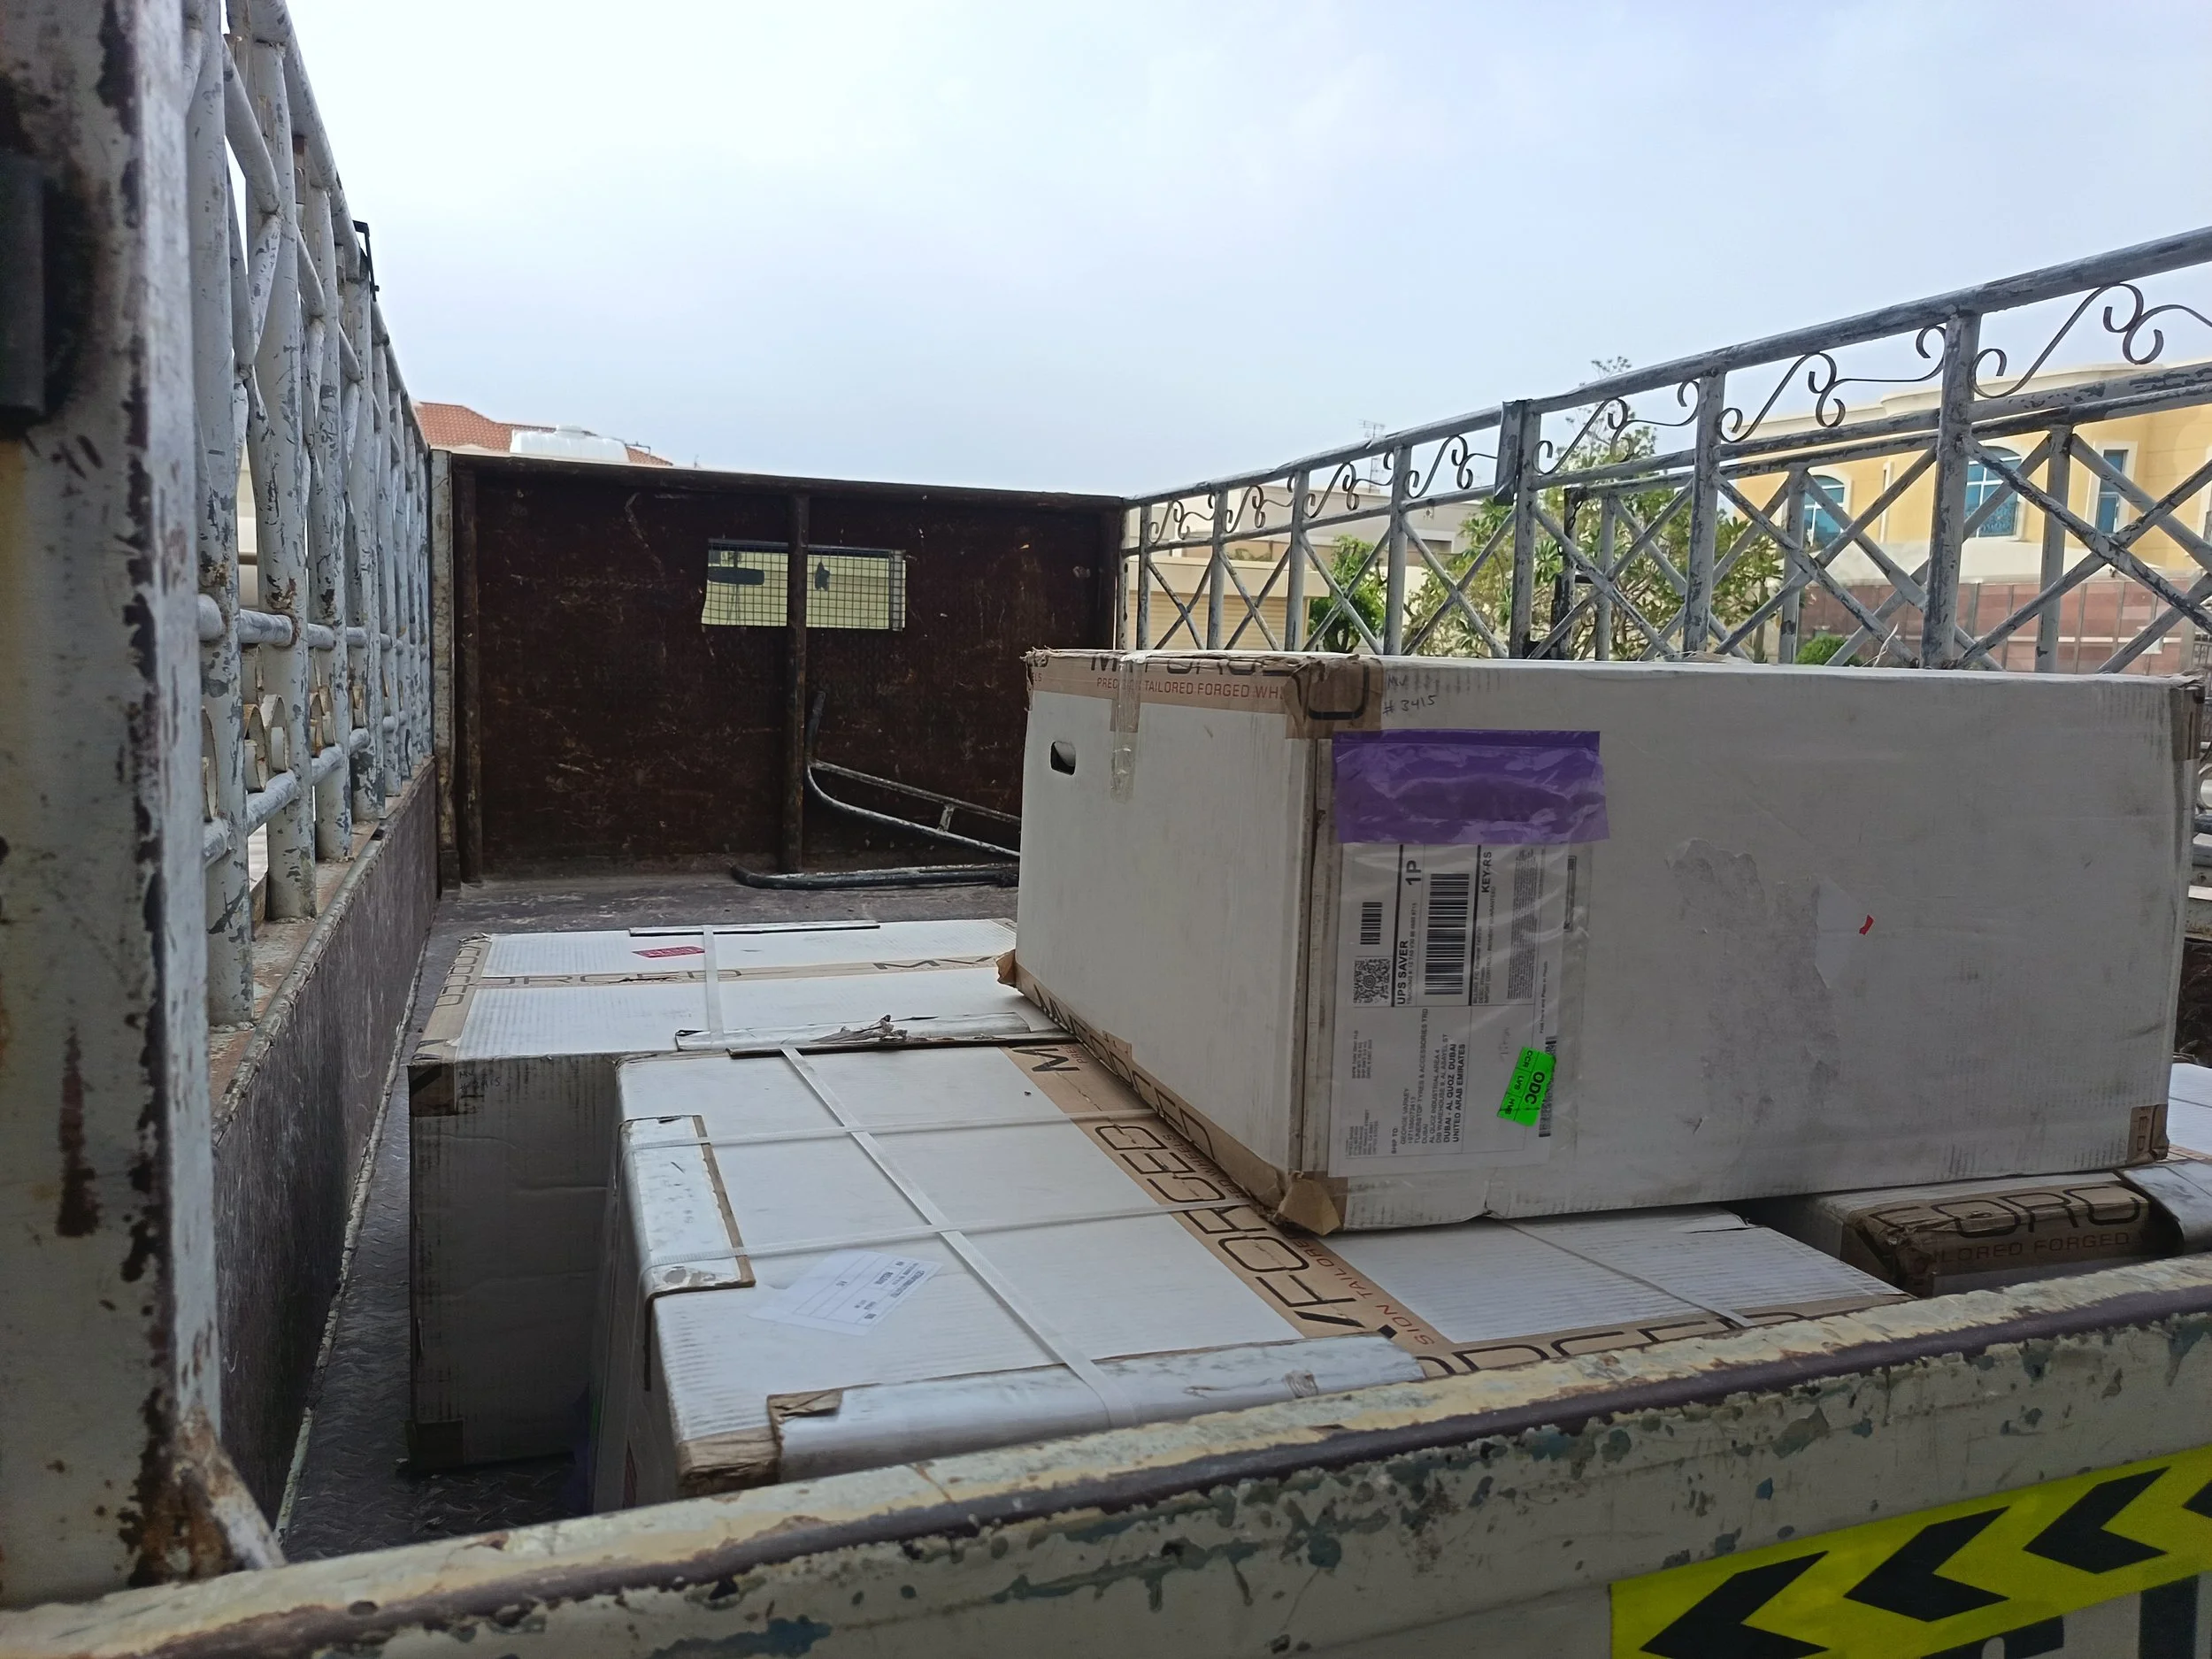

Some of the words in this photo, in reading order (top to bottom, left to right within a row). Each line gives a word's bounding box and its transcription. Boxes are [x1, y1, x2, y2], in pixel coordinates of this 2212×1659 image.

[1145, 680, 1194, 695] TAILORED
[1197, 683, 1249, 698] FORGED
[1405, 860, 1421, 885] 1P
[1481, 851, 1492, 893] KEY-RS
[1399, 941, 1409, 978] SAVER
[1456, 1044, 1465, 1086] EMIRATES
[1523, 1050, 1532, 1068] CCR
[1514, 1076, 1524, 1090] LVS
[1525, 1071, 1545, 1104] ODC
[1446, 1101, 1453, 1110] AL
[1163, 1133, 1217, 1176] WHEELS
[2035, 1231, 2130, 1253] FORGED
